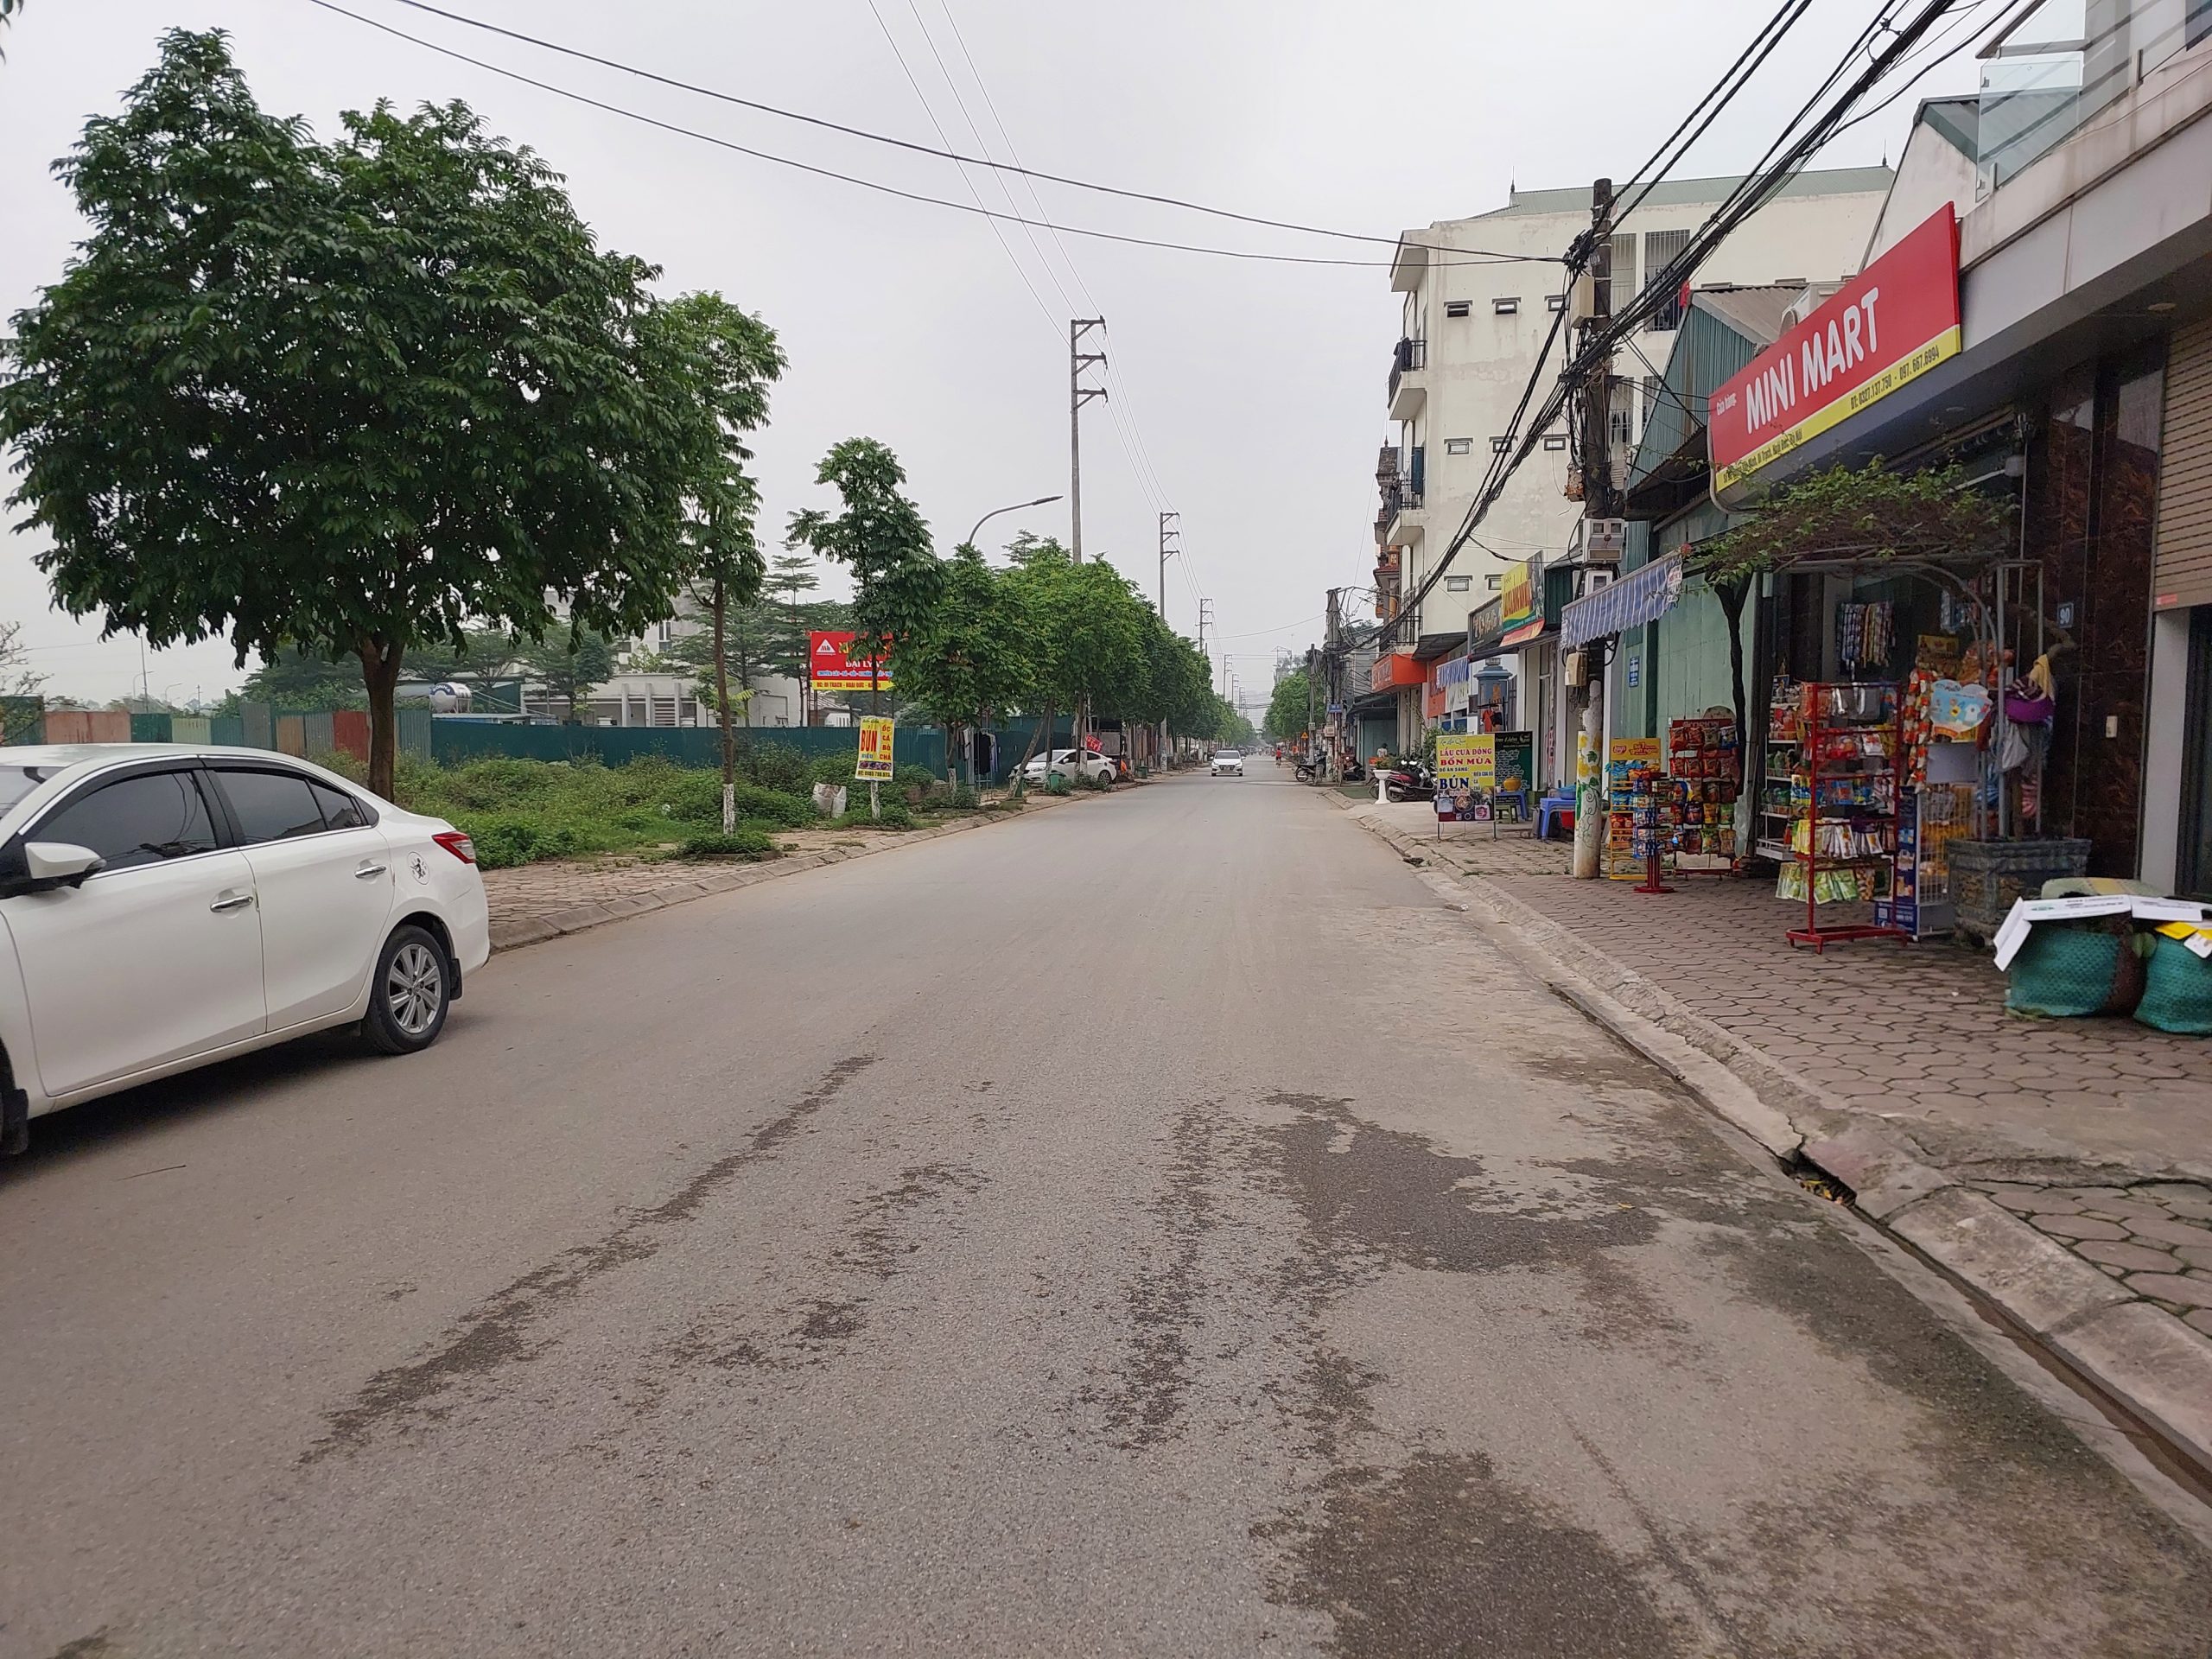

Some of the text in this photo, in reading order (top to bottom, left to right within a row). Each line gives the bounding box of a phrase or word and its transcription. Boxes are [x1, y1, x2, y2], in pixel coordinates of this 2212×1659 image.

[1745, 287, 1879, 434] MINI MART
[2060, 607, 2070, 625] 90
[861, 725, 877, 752] BÚN
[1440, 756, 1492, 766] BỐN MÙA
[1440, 774, 1469, 790] BÚN
